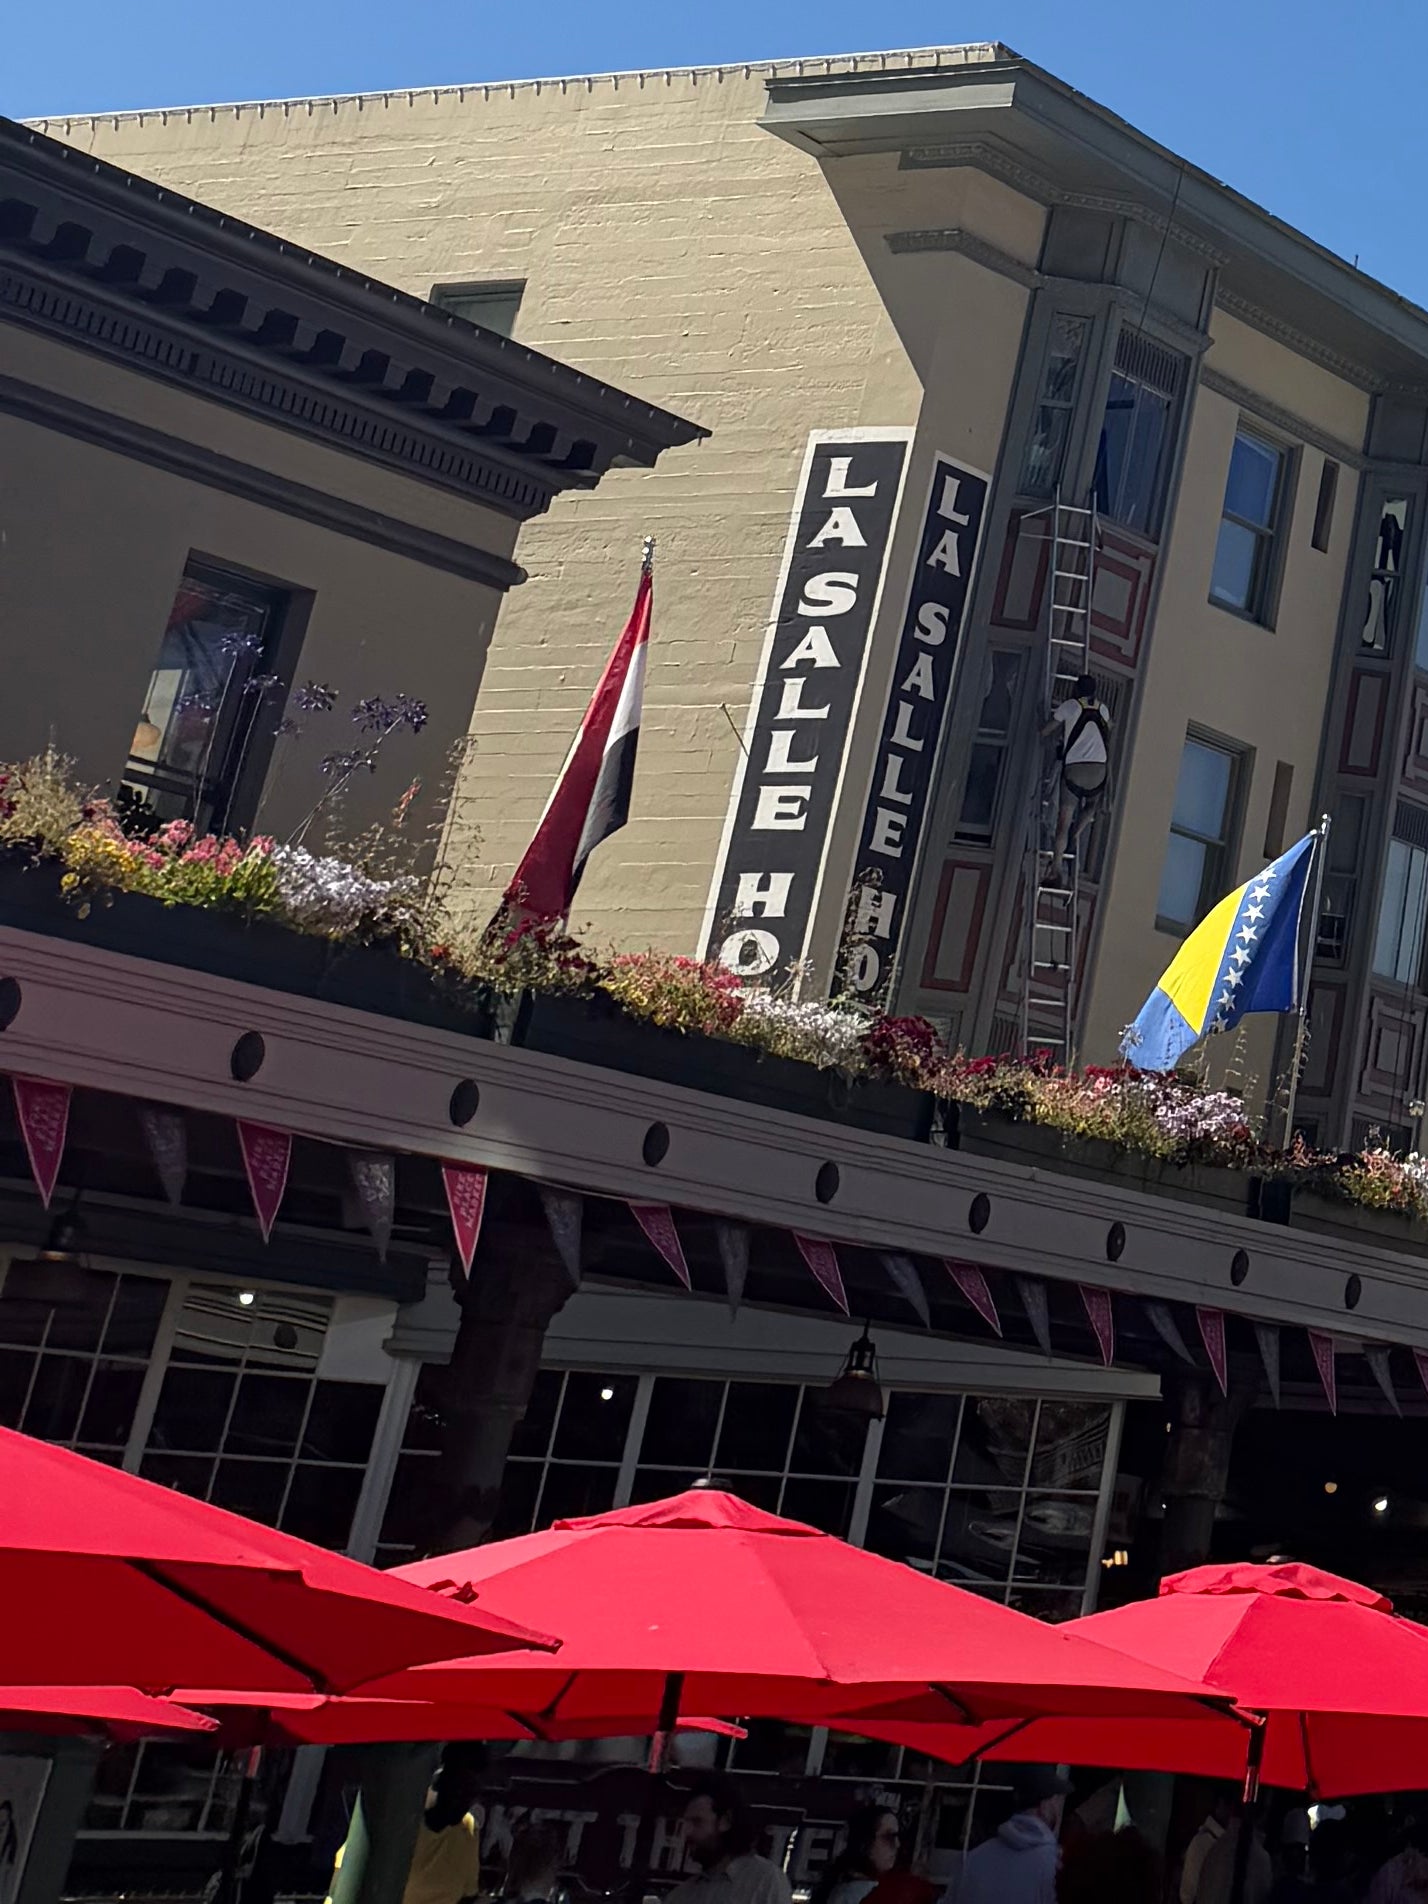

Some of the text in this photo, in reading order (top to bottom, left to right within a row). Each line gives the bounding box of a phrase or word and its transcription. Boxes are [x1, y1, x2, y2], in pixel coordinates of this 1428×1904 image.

[807, 455, 877, 549] LA
[925, 474, 970, 579] LA
[749, 571, 859, 833] SALLE
[868, 600, 951, 859] SALLE
